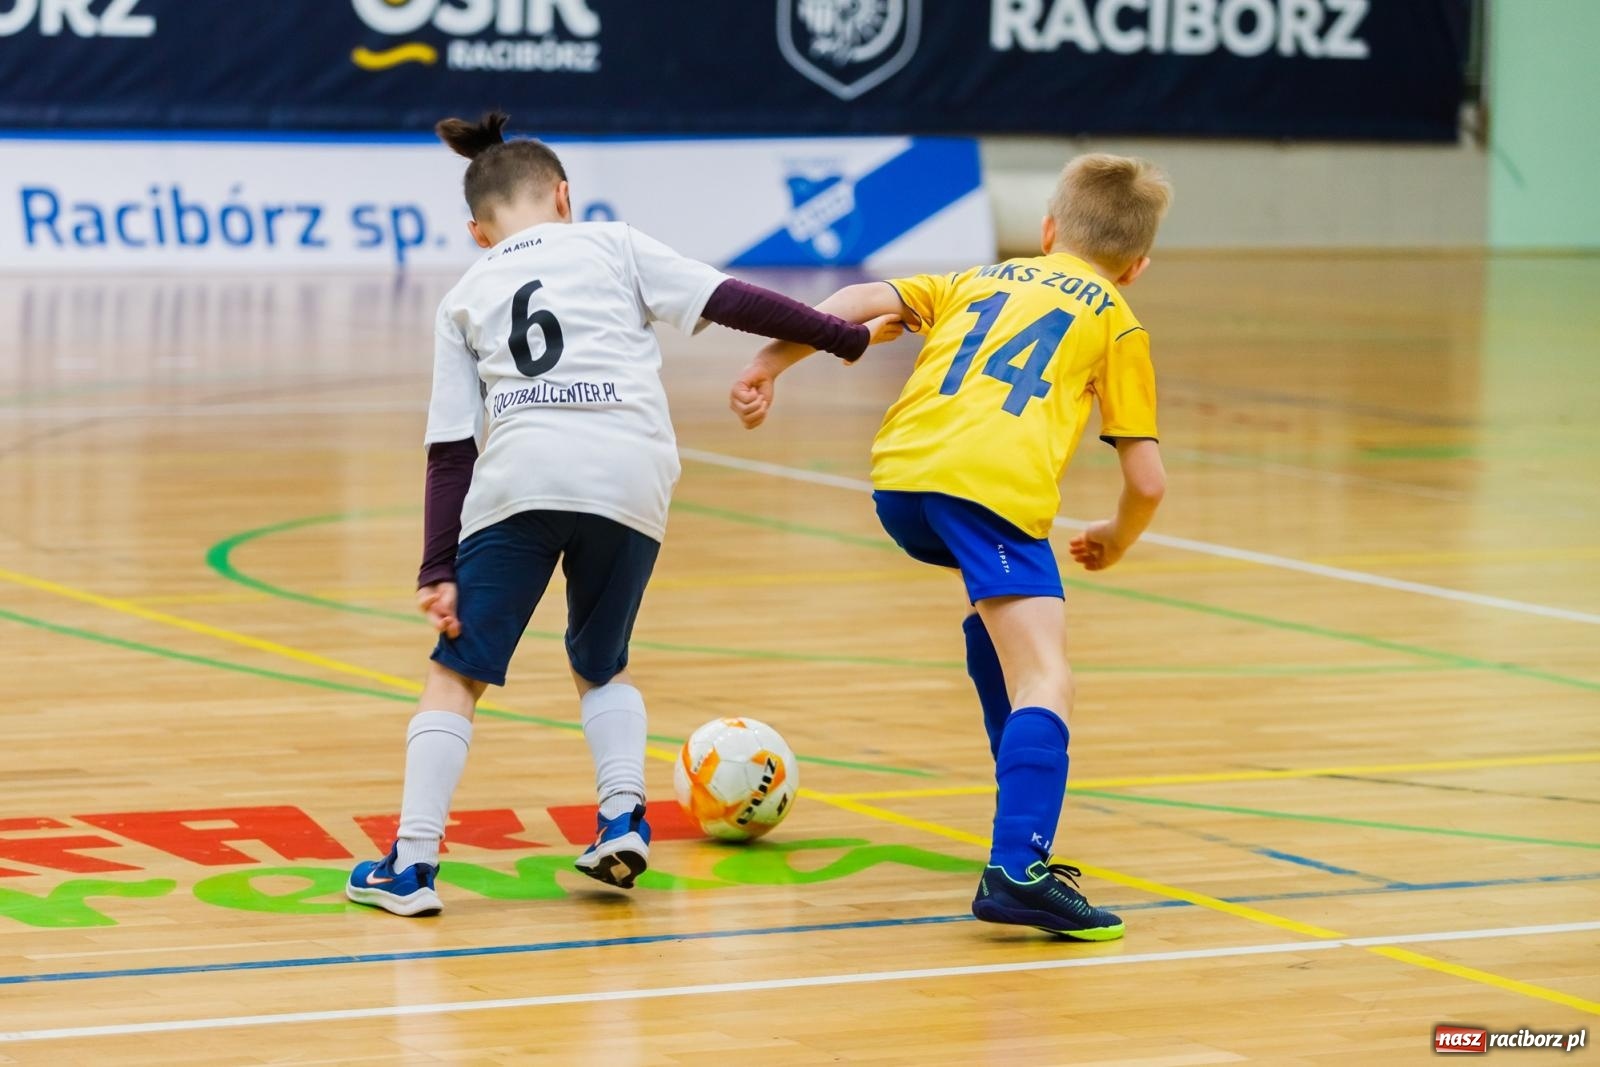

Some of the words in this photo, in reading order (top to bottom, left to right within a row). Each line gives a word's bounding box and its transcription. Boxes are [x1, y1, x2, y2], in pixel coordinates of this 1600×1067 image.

[19, 184, 327, 248] Racibórz
[351, 203, 447, 263] sp.
[502, 237, 543, 255] MASITA
[1041, 271, 1116, 317] ŻORY
[508, 279, 564, 377] 6
[939, 290, 1076, 417] 14
[493, 382, 623, 418] FOOTBALLCENTER.PL
[996, 543, 1011, 574] KIPSTA
